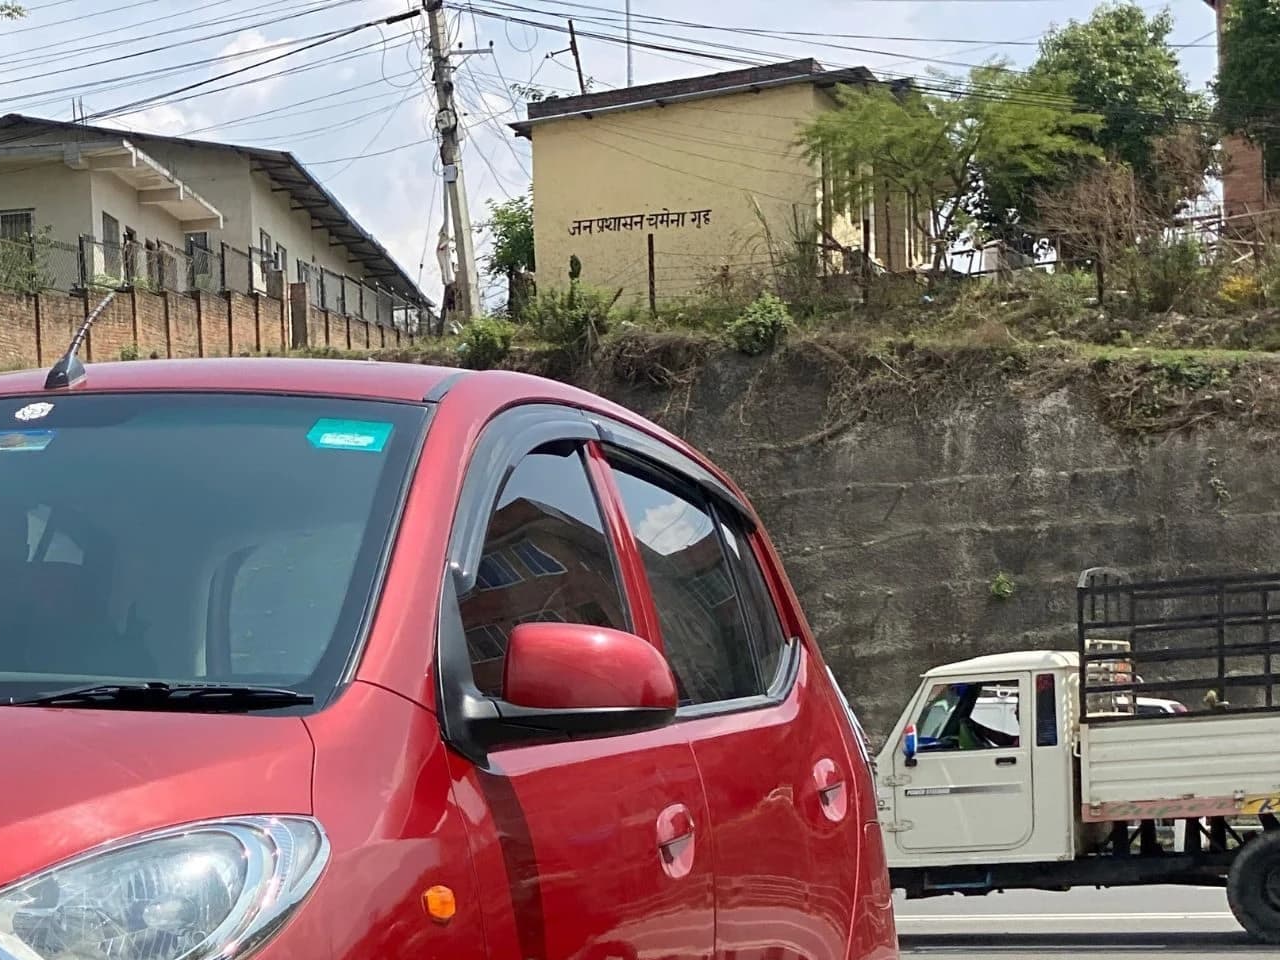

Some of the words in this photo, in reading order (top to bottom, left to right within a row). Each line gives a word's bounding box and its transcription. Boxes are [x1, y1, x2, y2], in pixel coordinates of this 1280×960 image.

[568, 218, 596, 236] जन
[645, 208, 687, 230] चमेना
[690, 209, 712, 229] गृह
